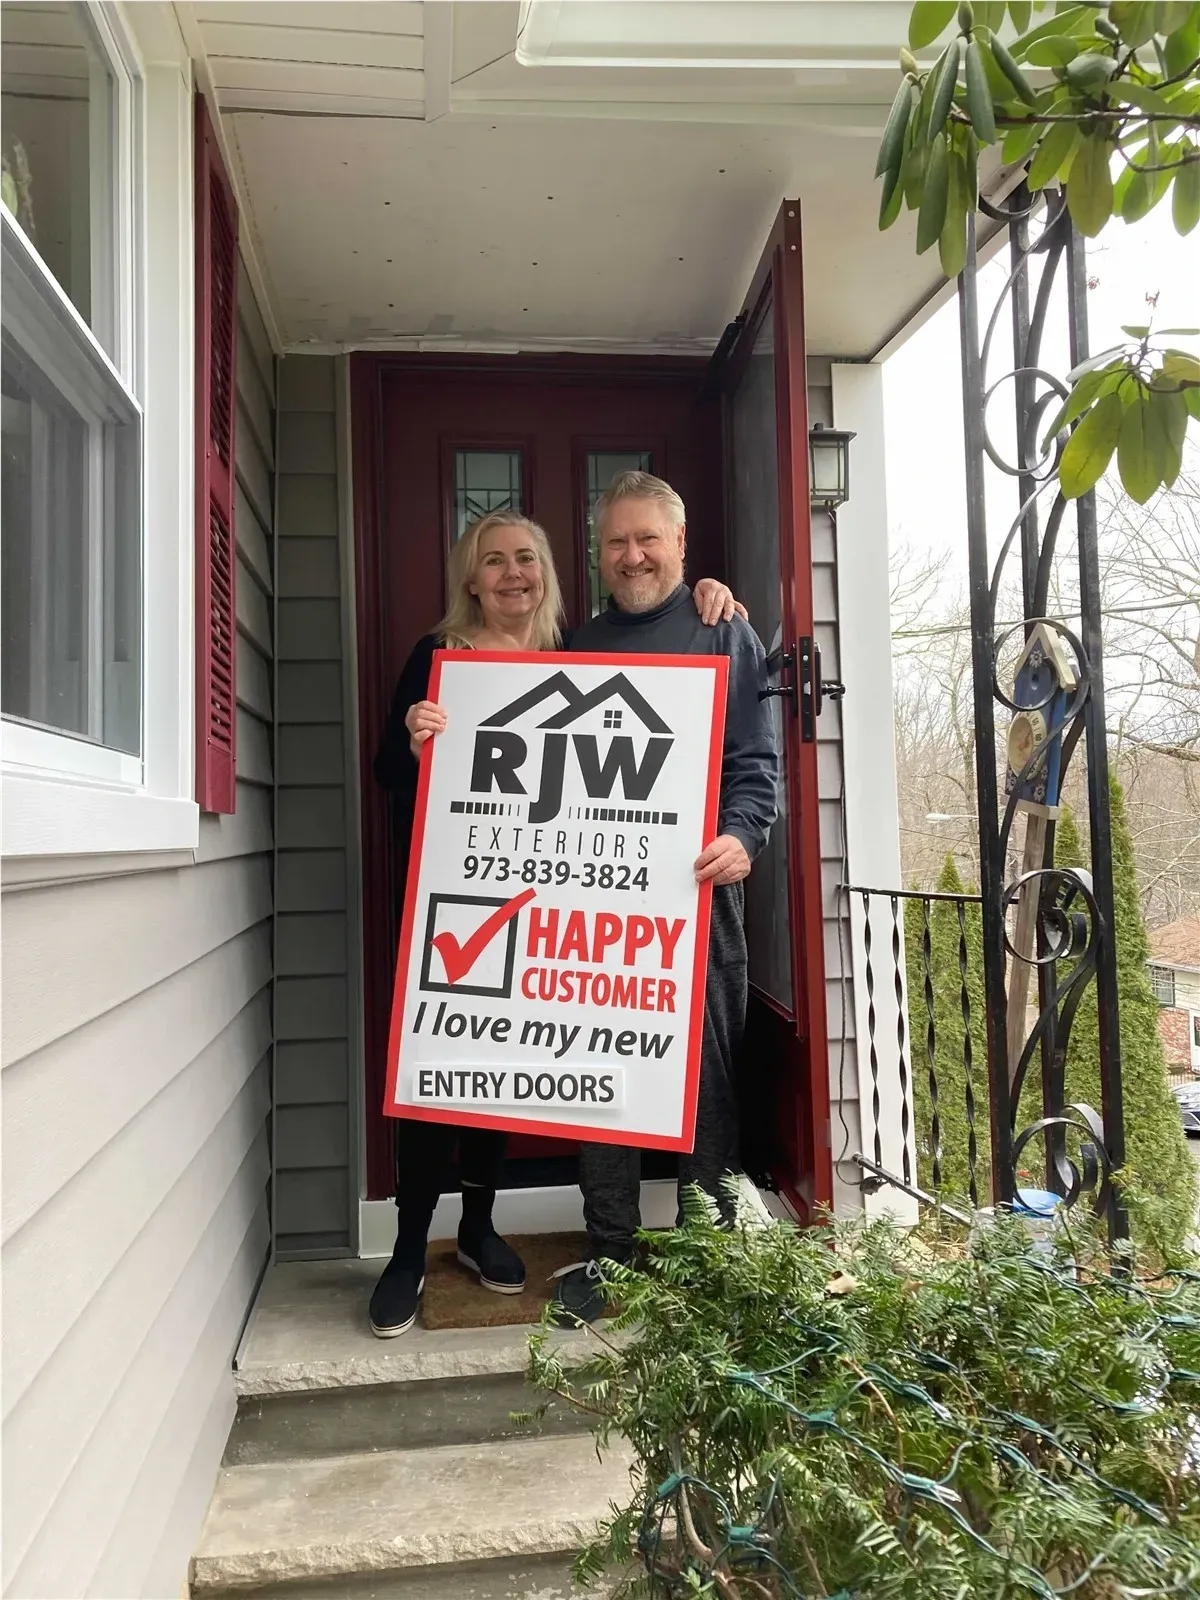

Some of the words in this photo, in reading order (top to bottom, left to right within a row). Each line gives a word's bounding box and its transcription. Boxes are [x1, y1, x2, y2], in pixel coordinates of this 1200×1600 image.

[470, 731, 674, 823] RJW
[468, 826, 649, 859] EXTERIORS
[464, 855, 649, 891] 973-839-3824
[526, 908, 686, 969] HAPPY
[522, 968, 676, 1012] CUSTOMER
[413, 1002, 427, 1033] I
[432, 1002, 511, 1042] love
[520, 1021, 581, 1058] my
[588, 1028, 674, 1059] new
[419, 1070, 506, 1099] ENTRY
[514, 1073, 614, 1102] DOORS
